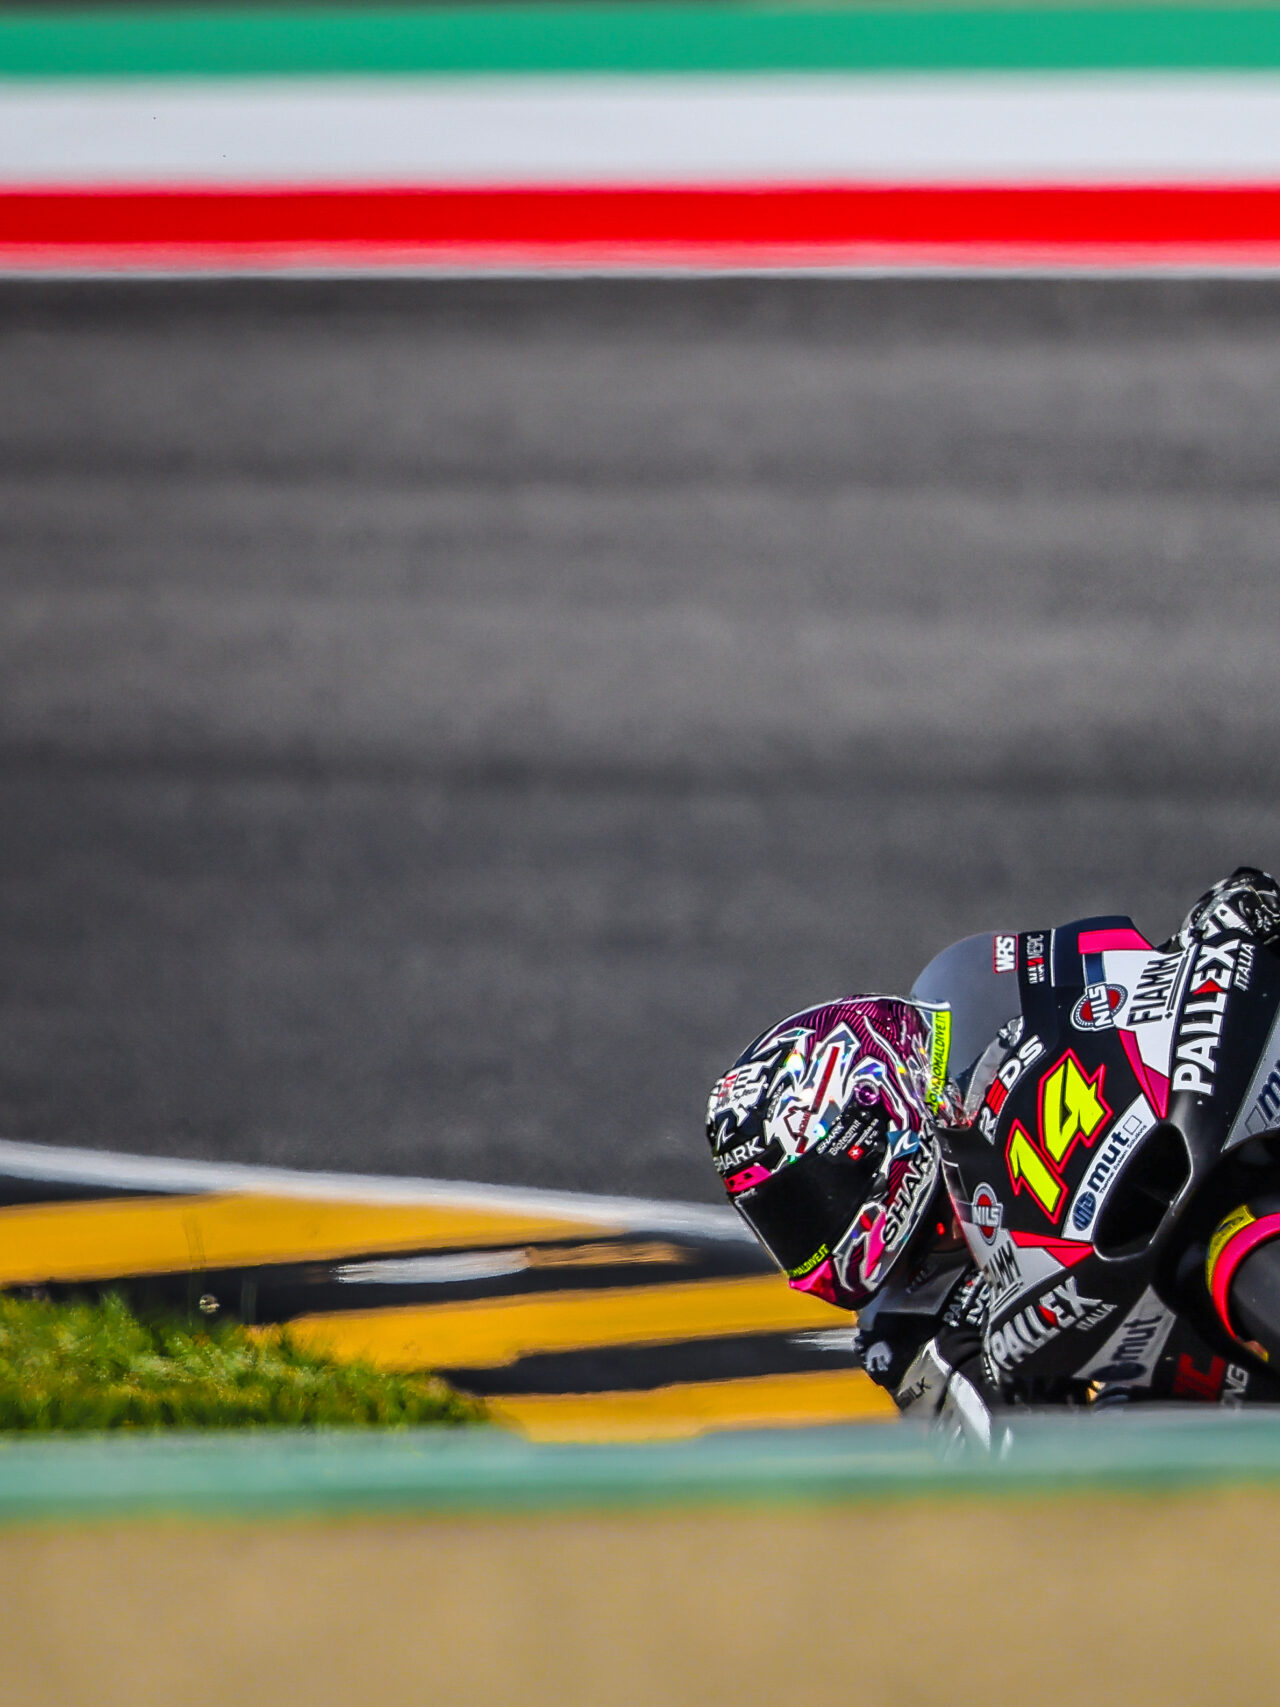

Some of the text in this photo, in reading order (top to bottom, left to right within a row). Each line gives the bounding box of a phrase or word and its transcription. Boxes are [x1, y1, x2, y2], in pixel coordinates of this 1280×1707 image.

[996, 935, 1015, 972] WRS
[1232, 943, 1255, 991] ITALIA
[1088, 985, 1112, 1028] NILS
[1173, 939, 1241, 1094] PALLEX
[816, 1121, 844, 1154] SHARK
[1008, 1053, 1109, 1217] 14
[881, 1120, 936, 1246] SHARK
[1087, 1131, 1129, 1193] mut
[973, 1206, 1000, 1226] NILS
[989, 1275, 1103, 1370] PALLEX
[1076, 1303, 1118, 1331] ITALIA
[1119, 1315, 1162, 1364] mut
